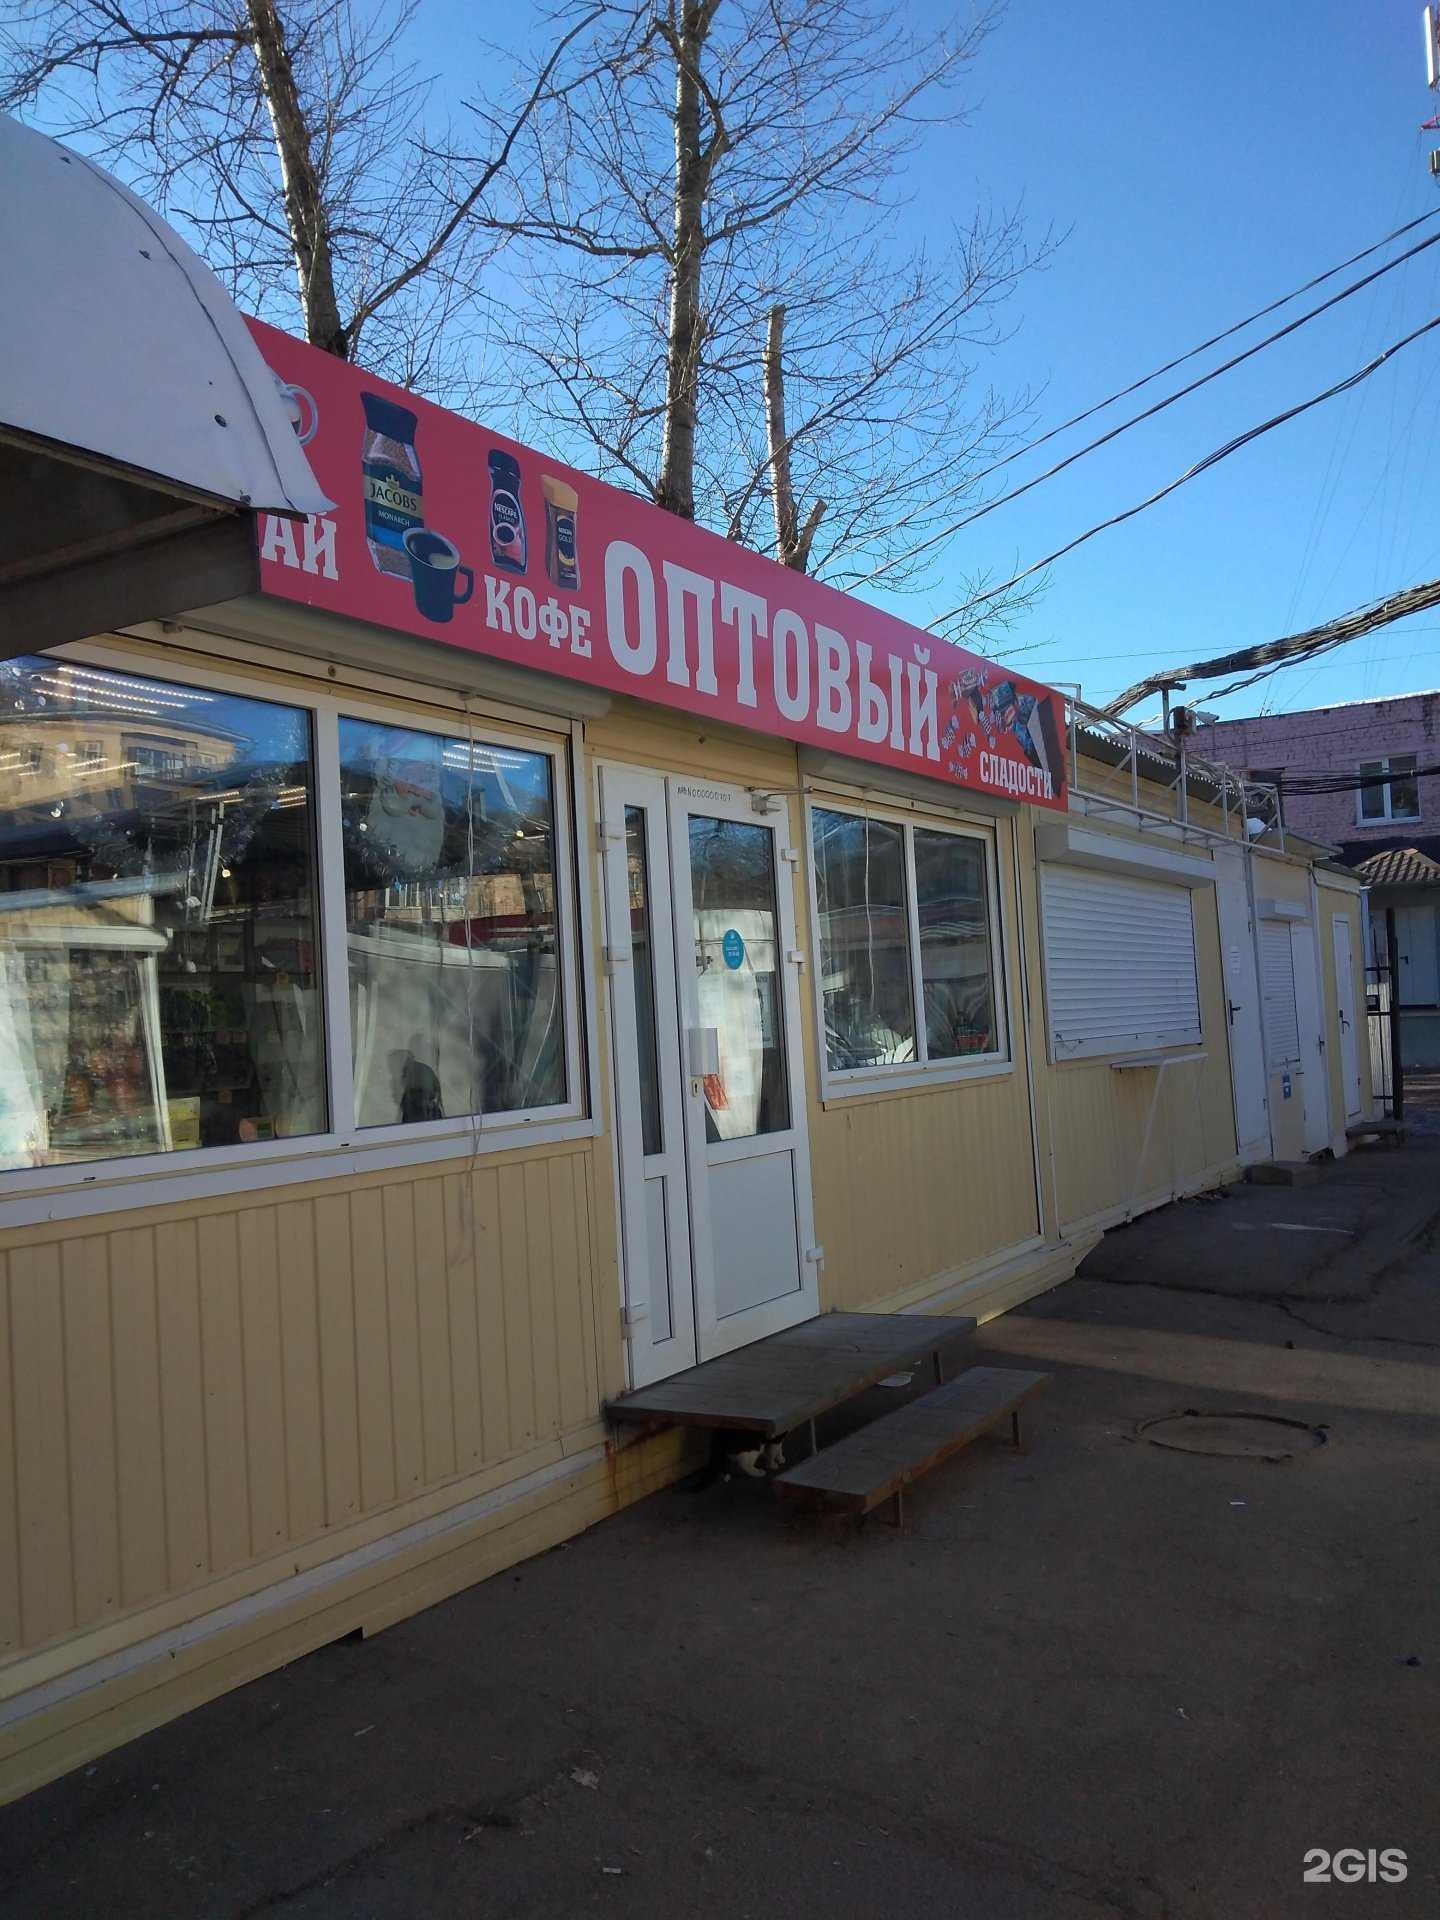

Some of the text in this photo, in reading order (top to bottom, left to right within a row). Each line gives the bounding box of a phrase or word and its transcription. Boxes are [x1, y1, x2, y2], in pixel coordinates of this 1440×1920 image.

[370, 482, 417, 512] JACOBS
[377, 510, 410, 527] MONARCH
[484, 575, 592, 659] КОФЕ
[604, 540, 941, 762] ОПТОВЫЙ
[979, 751, 1053, 800] СЛАДОСТИ
